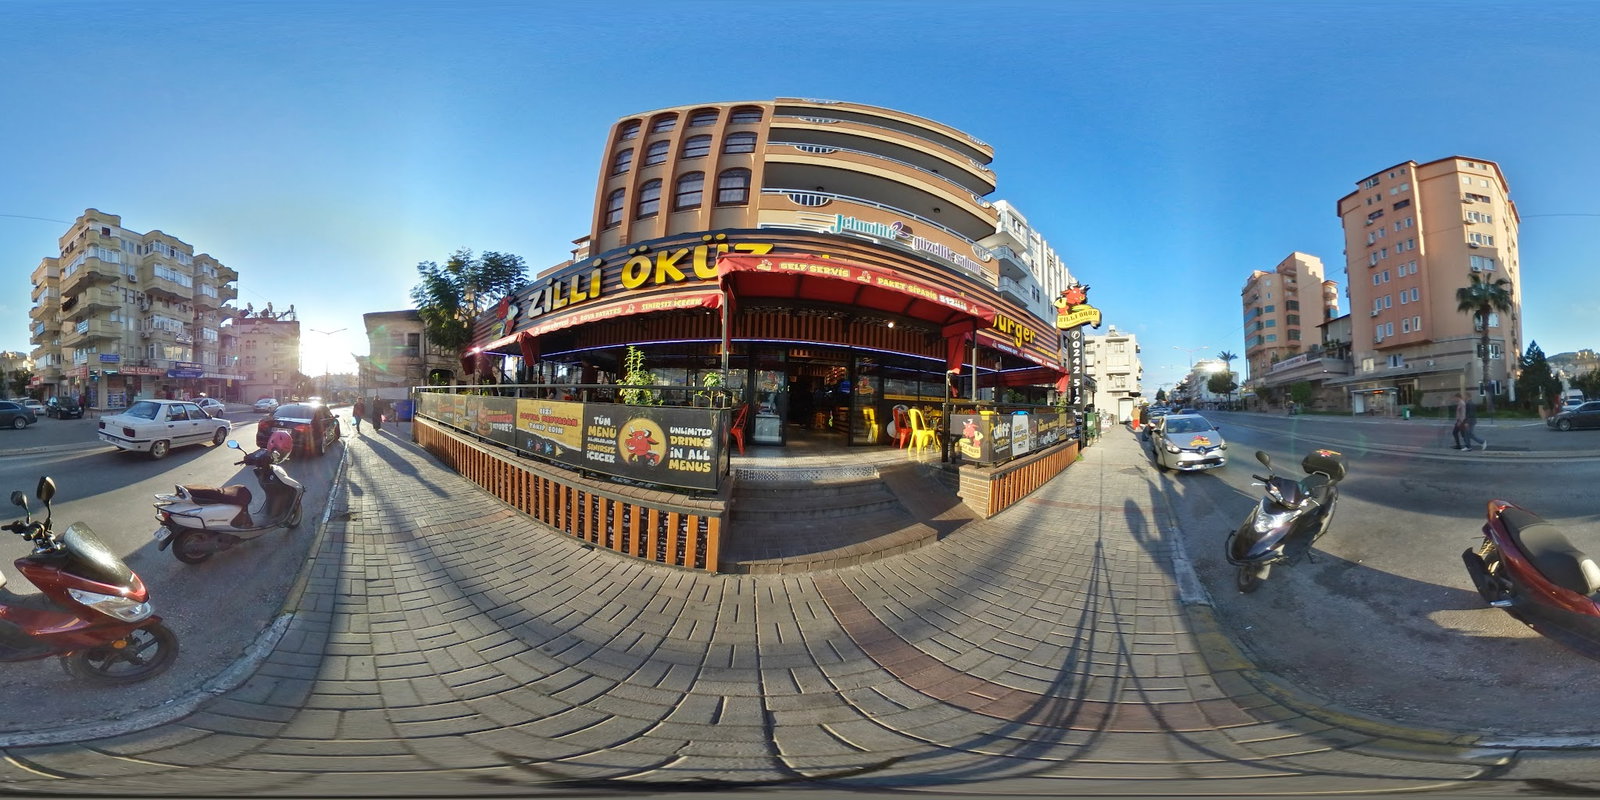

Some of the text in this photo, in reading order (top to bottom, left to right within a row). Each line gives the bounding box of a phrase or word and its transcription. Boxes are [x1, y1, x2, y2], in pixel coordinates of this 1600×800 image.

[808, 265, 850, 277] SERVİS
[527, 258, 603, 318] ZİLLİ
[594, 415, 611, 426] TÜM
[587, 425, 617, 438] MENÜ
[586, 451, 616, 463] İÇECEK
[687, 449, 711, 461] ALL
[668, 459, 711, 473] MENUS
